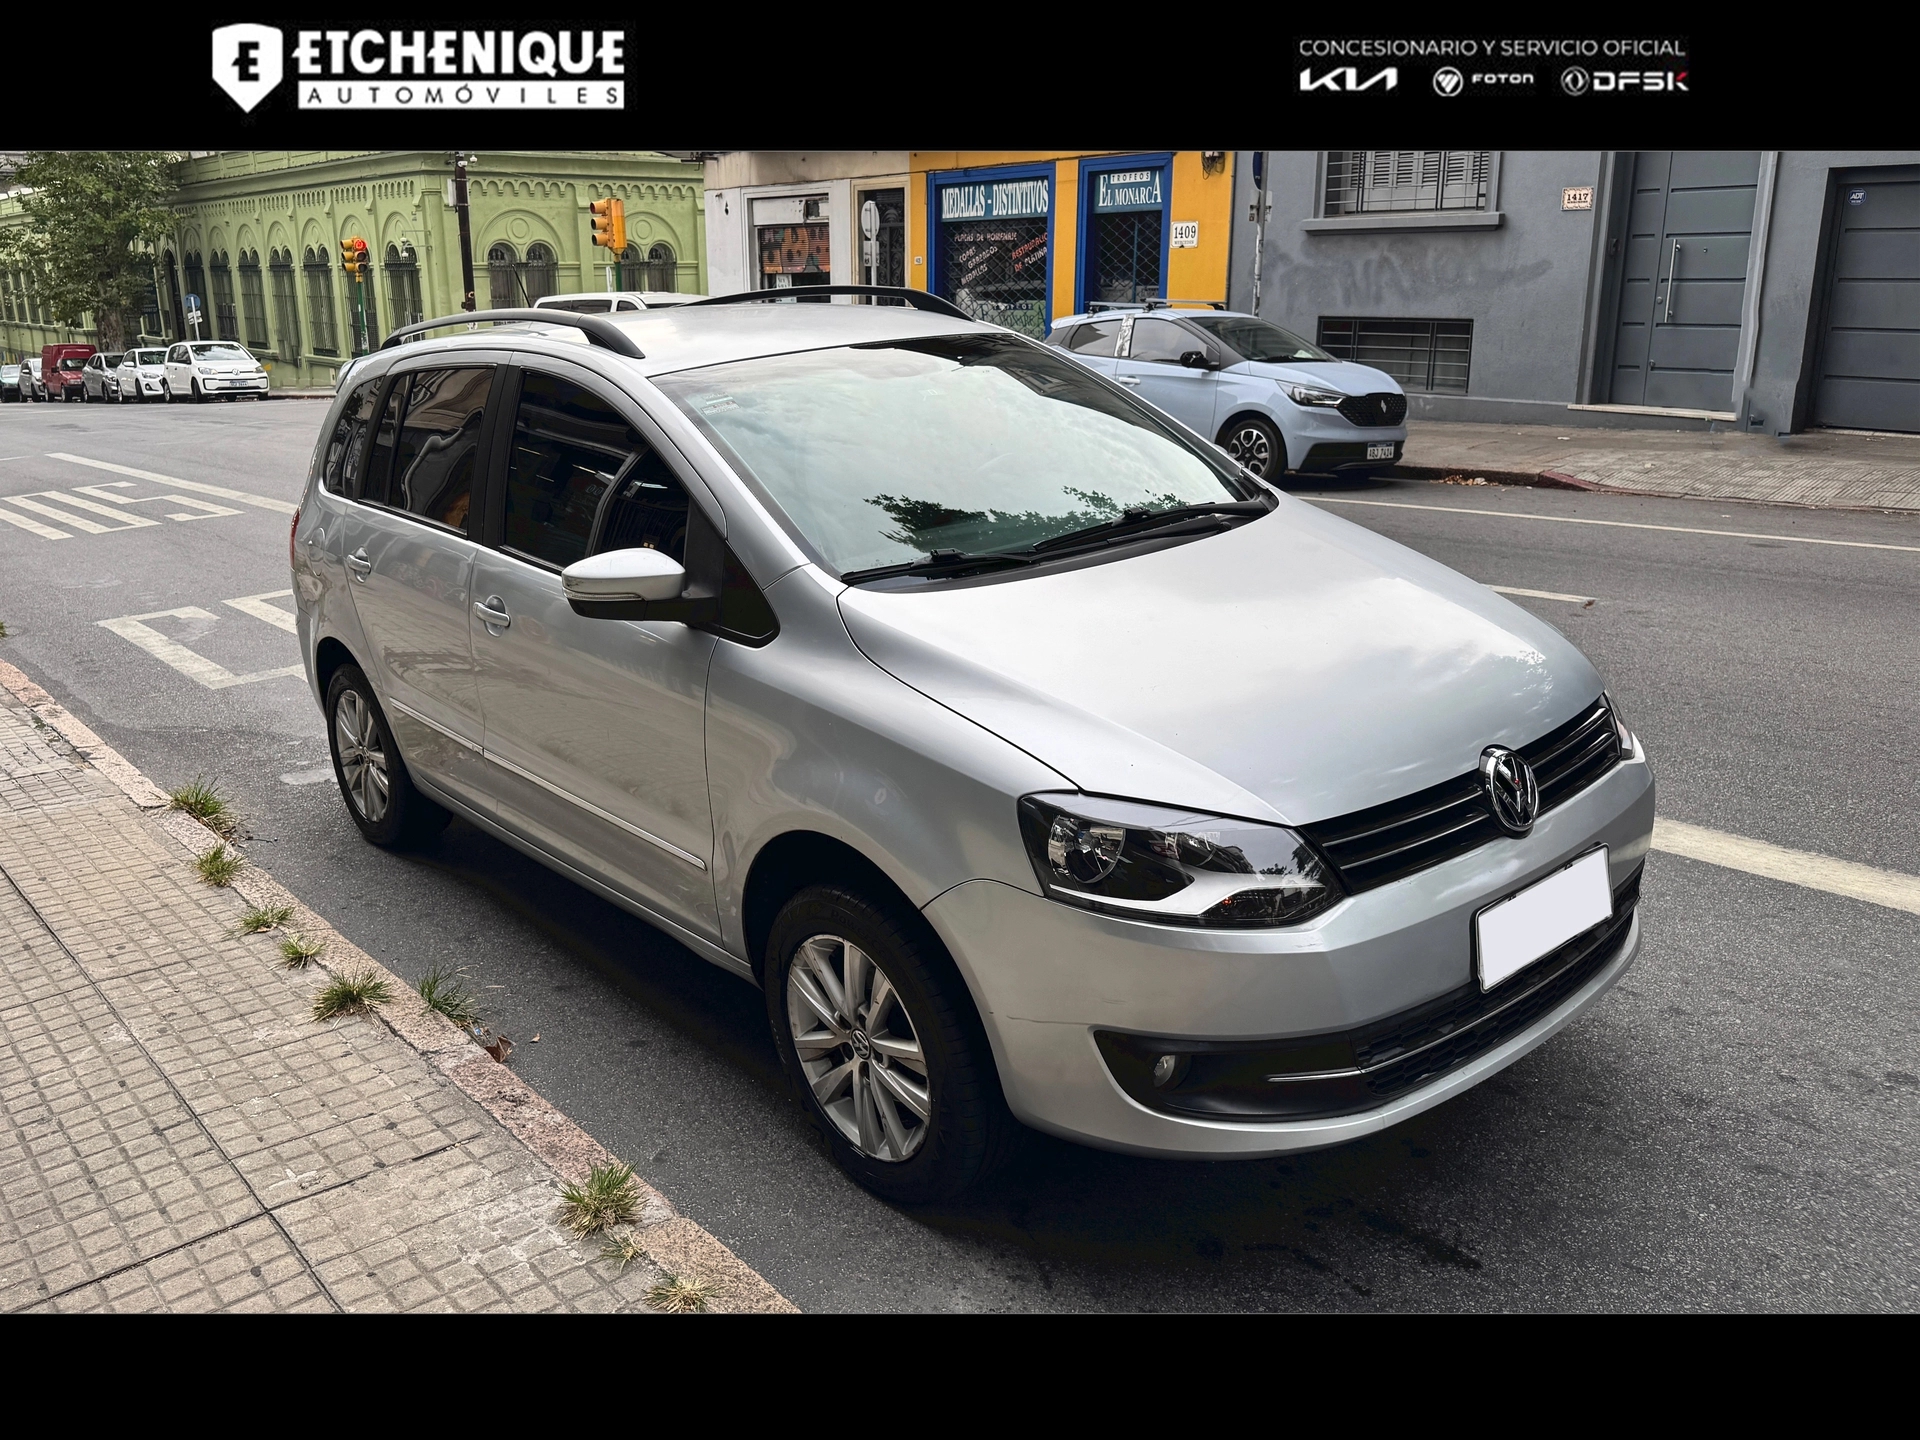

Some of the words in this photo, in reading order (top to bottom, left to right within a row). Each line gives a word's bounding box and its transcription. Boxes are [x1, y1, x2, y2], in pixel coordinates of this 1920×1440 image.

[1112, 172, 1150, 182] TROFEOS
[1114, 170, 1162, 206] MONARCA
[942, 184, 986, 219] MEDALLAS
[992, 179, 1049, 216] DISTINTIVOS
[1567, 193, 1589, 201] 1417
[1850, 192, 1865, 200] ADT
[1174, 225, 1197, 239] 1409
